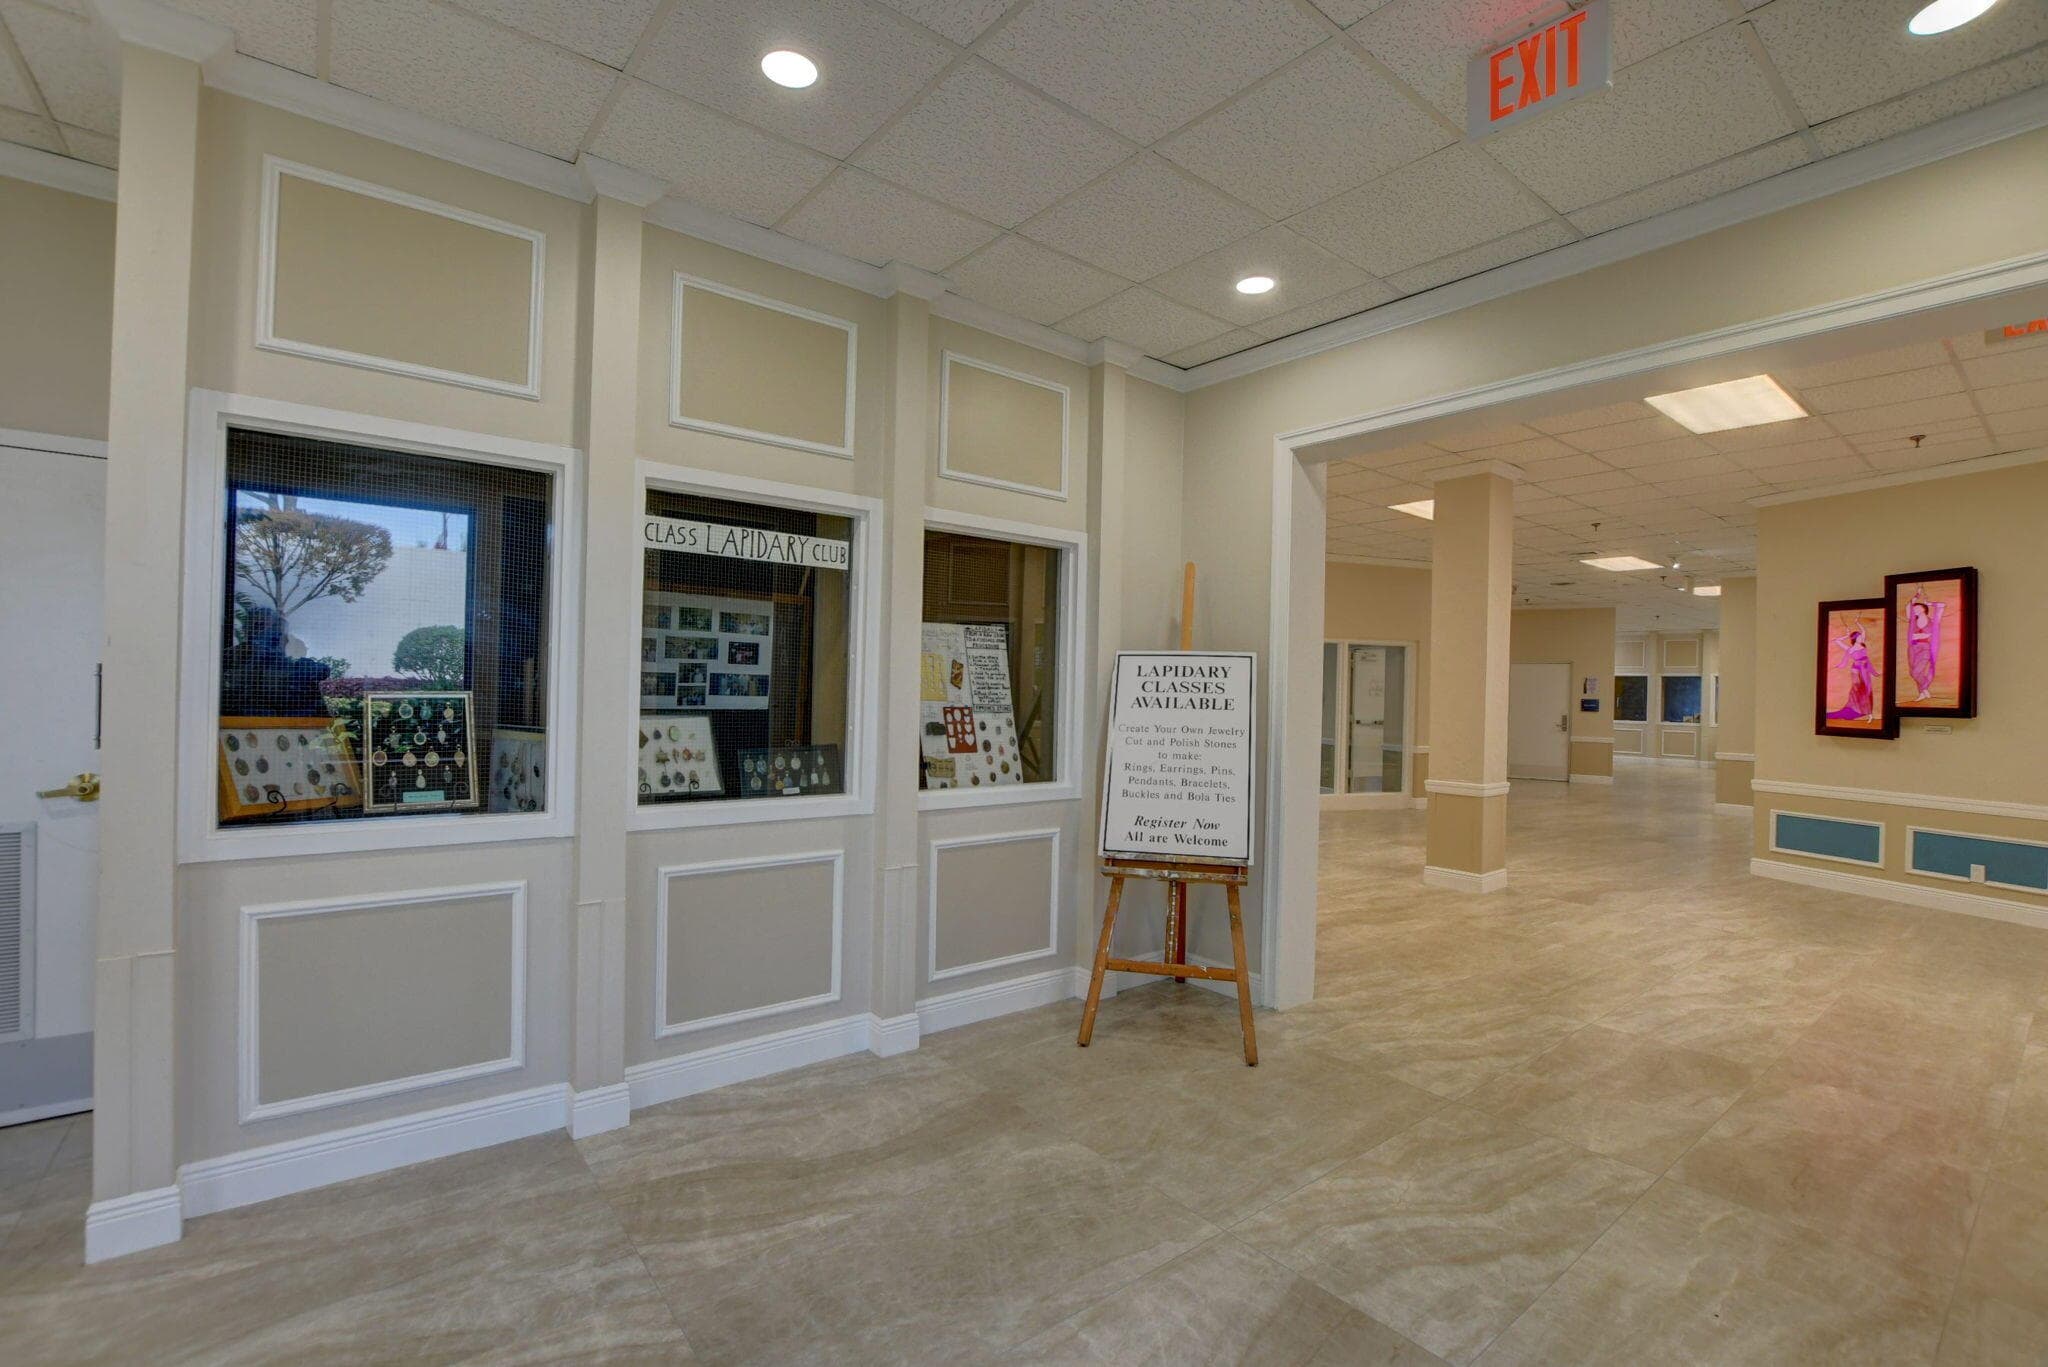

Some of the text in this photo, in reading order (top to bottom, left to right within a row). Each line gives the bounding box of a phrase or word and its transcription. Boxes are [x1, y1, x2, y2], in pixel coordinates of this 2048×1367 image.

[1489, 10, 1588, 122] EXIT
[644, 522, 847, 564] CLASS LAPIDARY CLUB
[1136, 665, 1232, 679] LAPIDARY
[1141, 681, 1225, 694] CLASSES
[1130, 696, 1235, 711] AVAILABLE
[1118, 724, 1245, 737] Create Your Own Jewelry
[1125, 737, 1237, 749] Cut and Polish Stones
[1158, 751, 1202, 760] to make:
[1124, 763, 1236, 776] Rings, Earrings, Pins,
[1128, 776, 1230, 789] Pendants, Bracelets,
[1122, 789, 1236, 803] Buckles and Bola Ties
[1134, 815, 1220, 830] Register Now
[1124, 831, 1228, 847] All are Welcome
